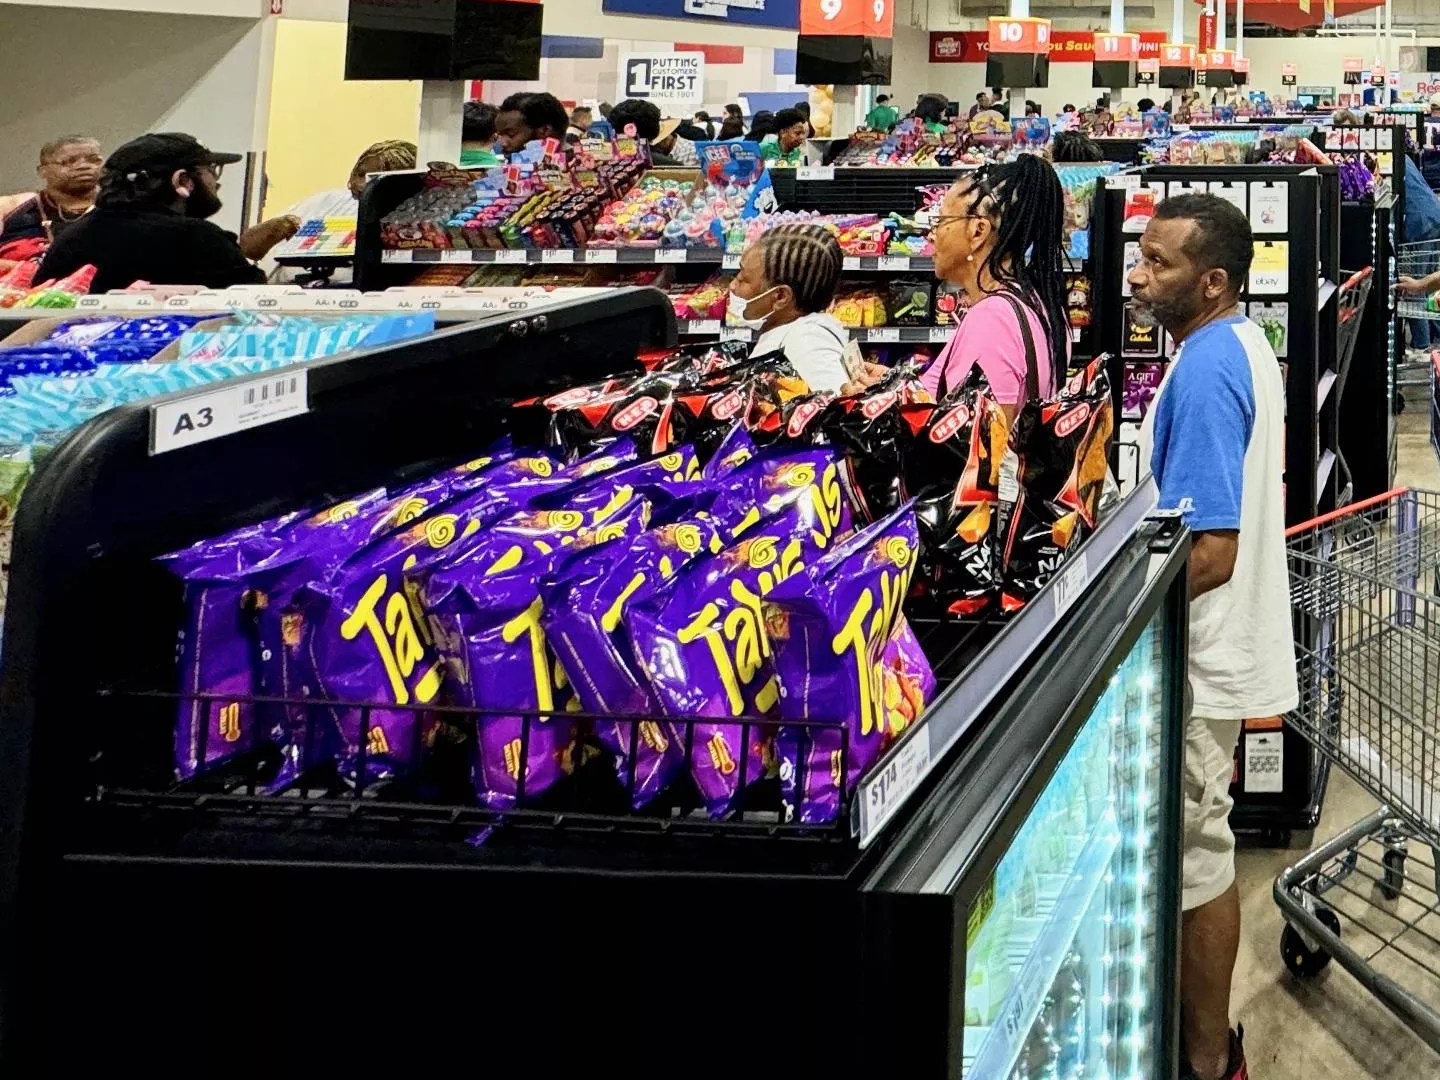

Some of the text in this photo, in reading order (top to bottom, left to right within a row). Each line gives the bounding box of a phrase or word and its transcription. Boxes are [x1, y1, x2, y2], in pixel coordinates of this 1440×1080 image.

[999, 23, 1023, 41] 10
[1103, 37, 1118, 52] 11
[652, 58, 697, 67] PUTTING
[651, 76, 696, 90] FIRST
[172, 407, 214, 435] A3
